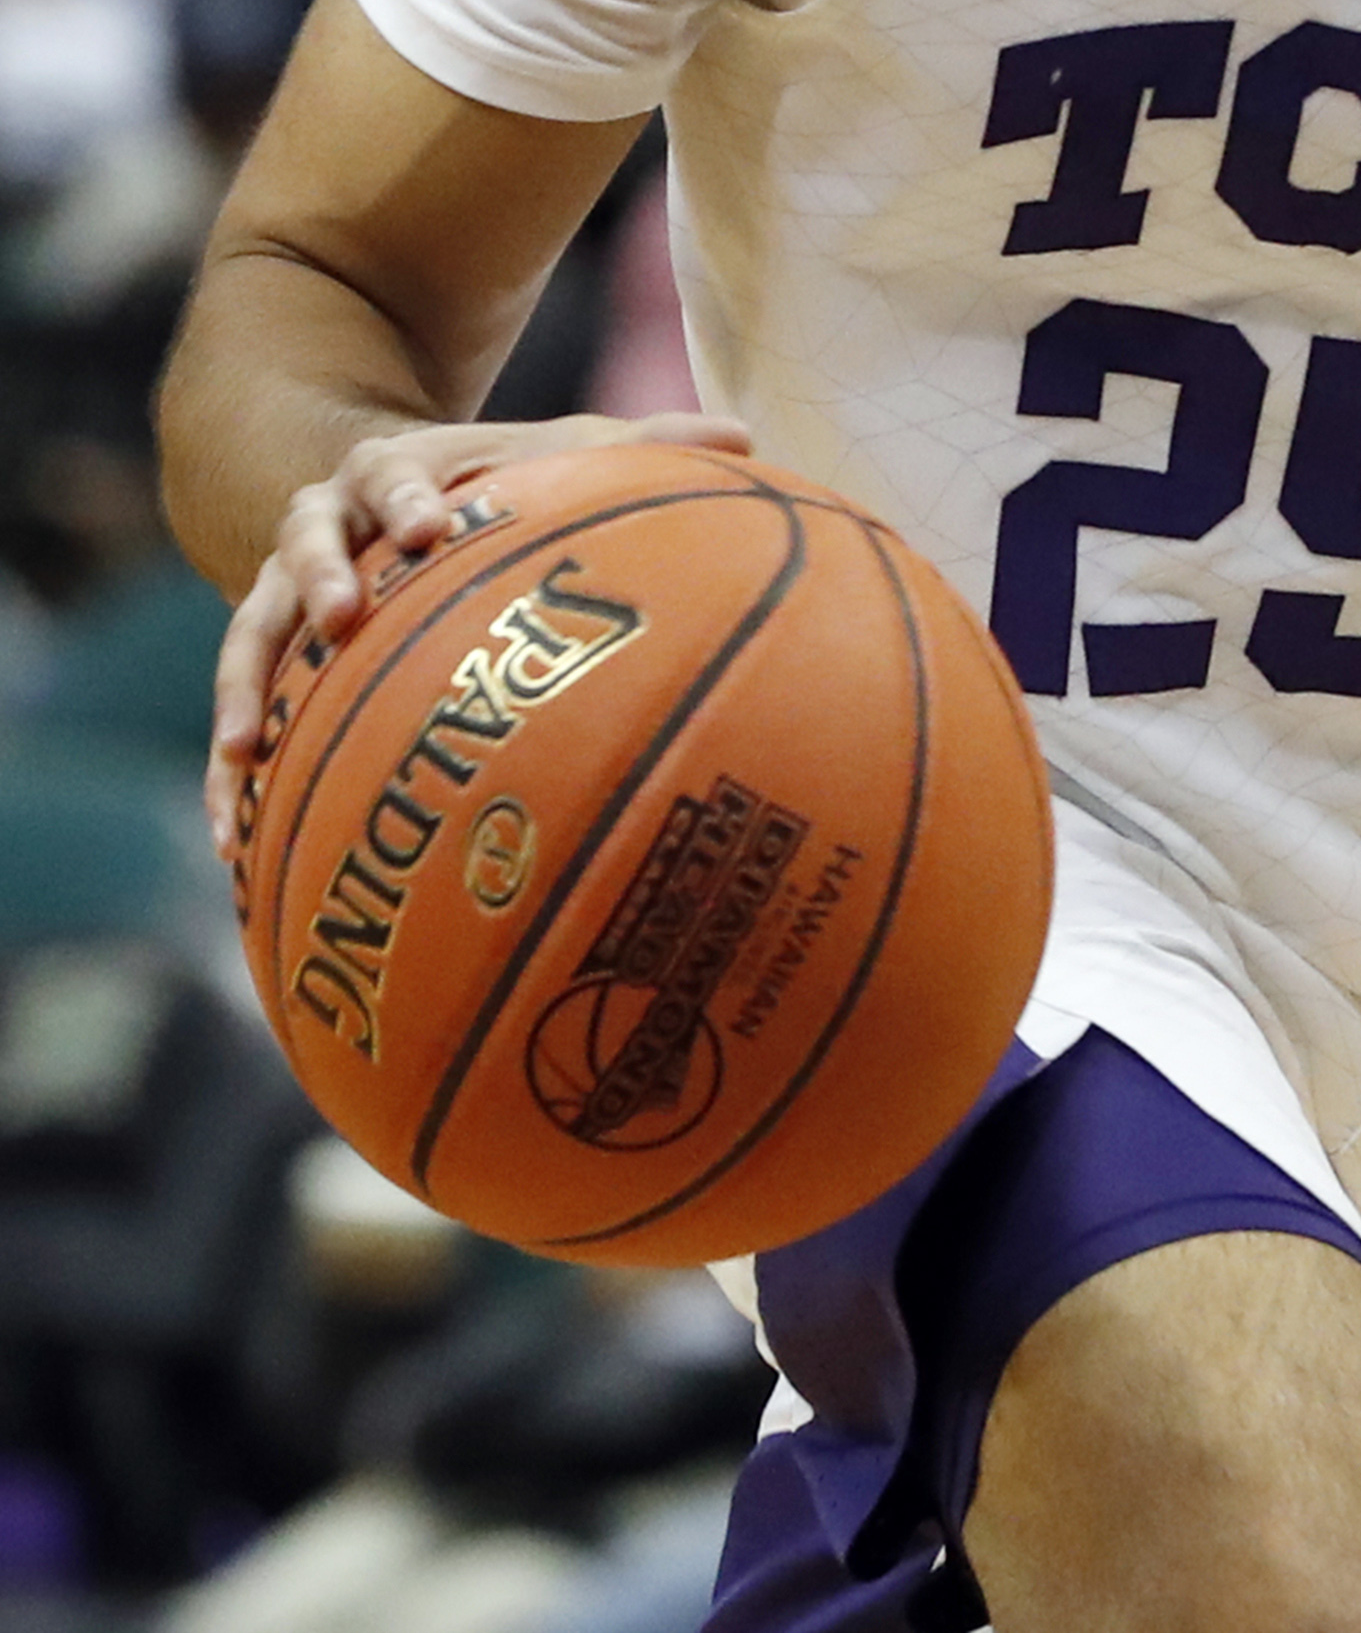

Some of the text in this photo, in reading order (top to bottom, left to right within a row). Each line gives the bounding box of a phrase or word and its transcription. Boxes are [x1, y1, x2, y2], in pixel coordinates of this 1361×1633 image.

[292, 555, 650, 1065] SPALDING
[622, 782, 757, 977] HEAD
[590, 805, 806, 1129] DIAMOND
[728, 842, 864, 1039] HAWAIIAN
